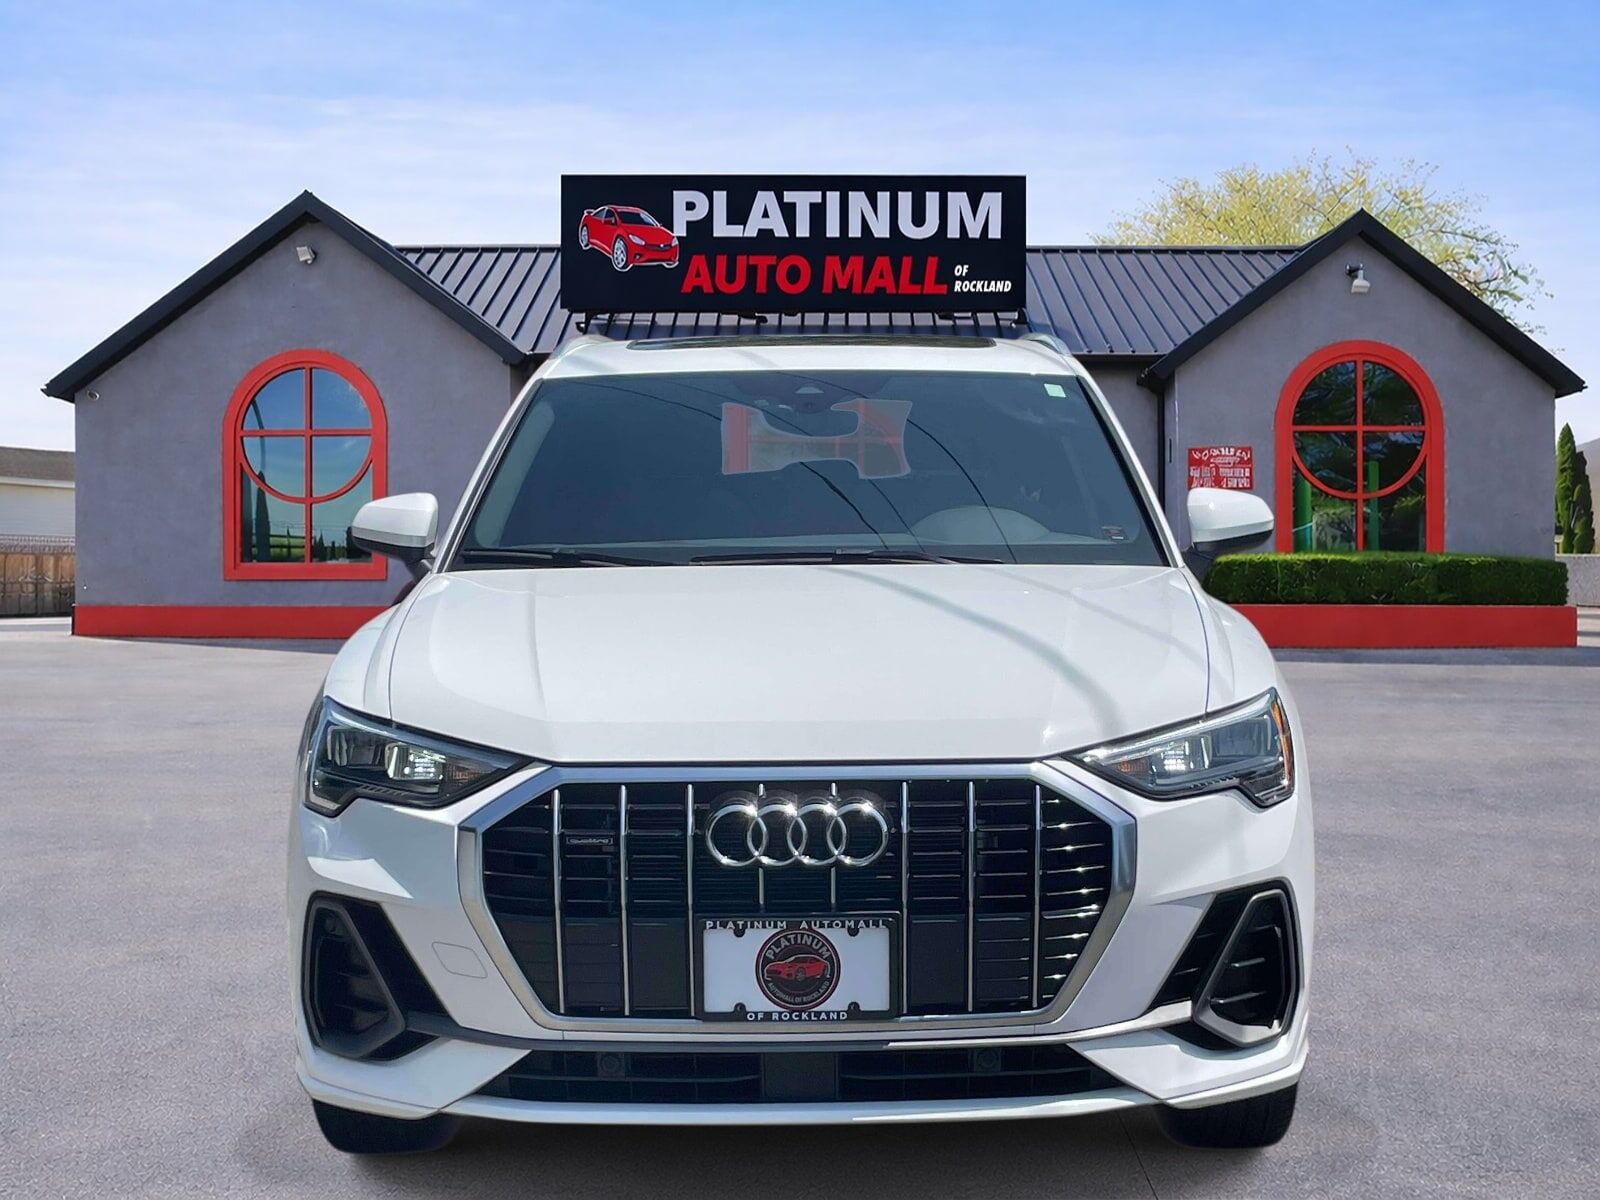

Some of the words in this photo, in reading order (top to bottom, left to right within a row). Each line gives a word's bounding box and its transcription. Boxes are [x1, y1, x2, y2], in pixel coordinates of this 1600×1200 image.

[672, 190, 1003, 239] PLATINUM
[681, 255, 811, 294] AUTO
[821, 255, 948, 295] MALL
[954, 264, 969, 277] OF
[954, 280, 1012, 292] ROCKLAND
[705, 920, 788, 930] PLATINUM
[799, 919, 887, 930] AUTOMALL
[765, 934, 831, 960] PLATINUM
[746, 1012, 764, 1021] OF
[771, 1011, 848, 1021] ROCKLAND
